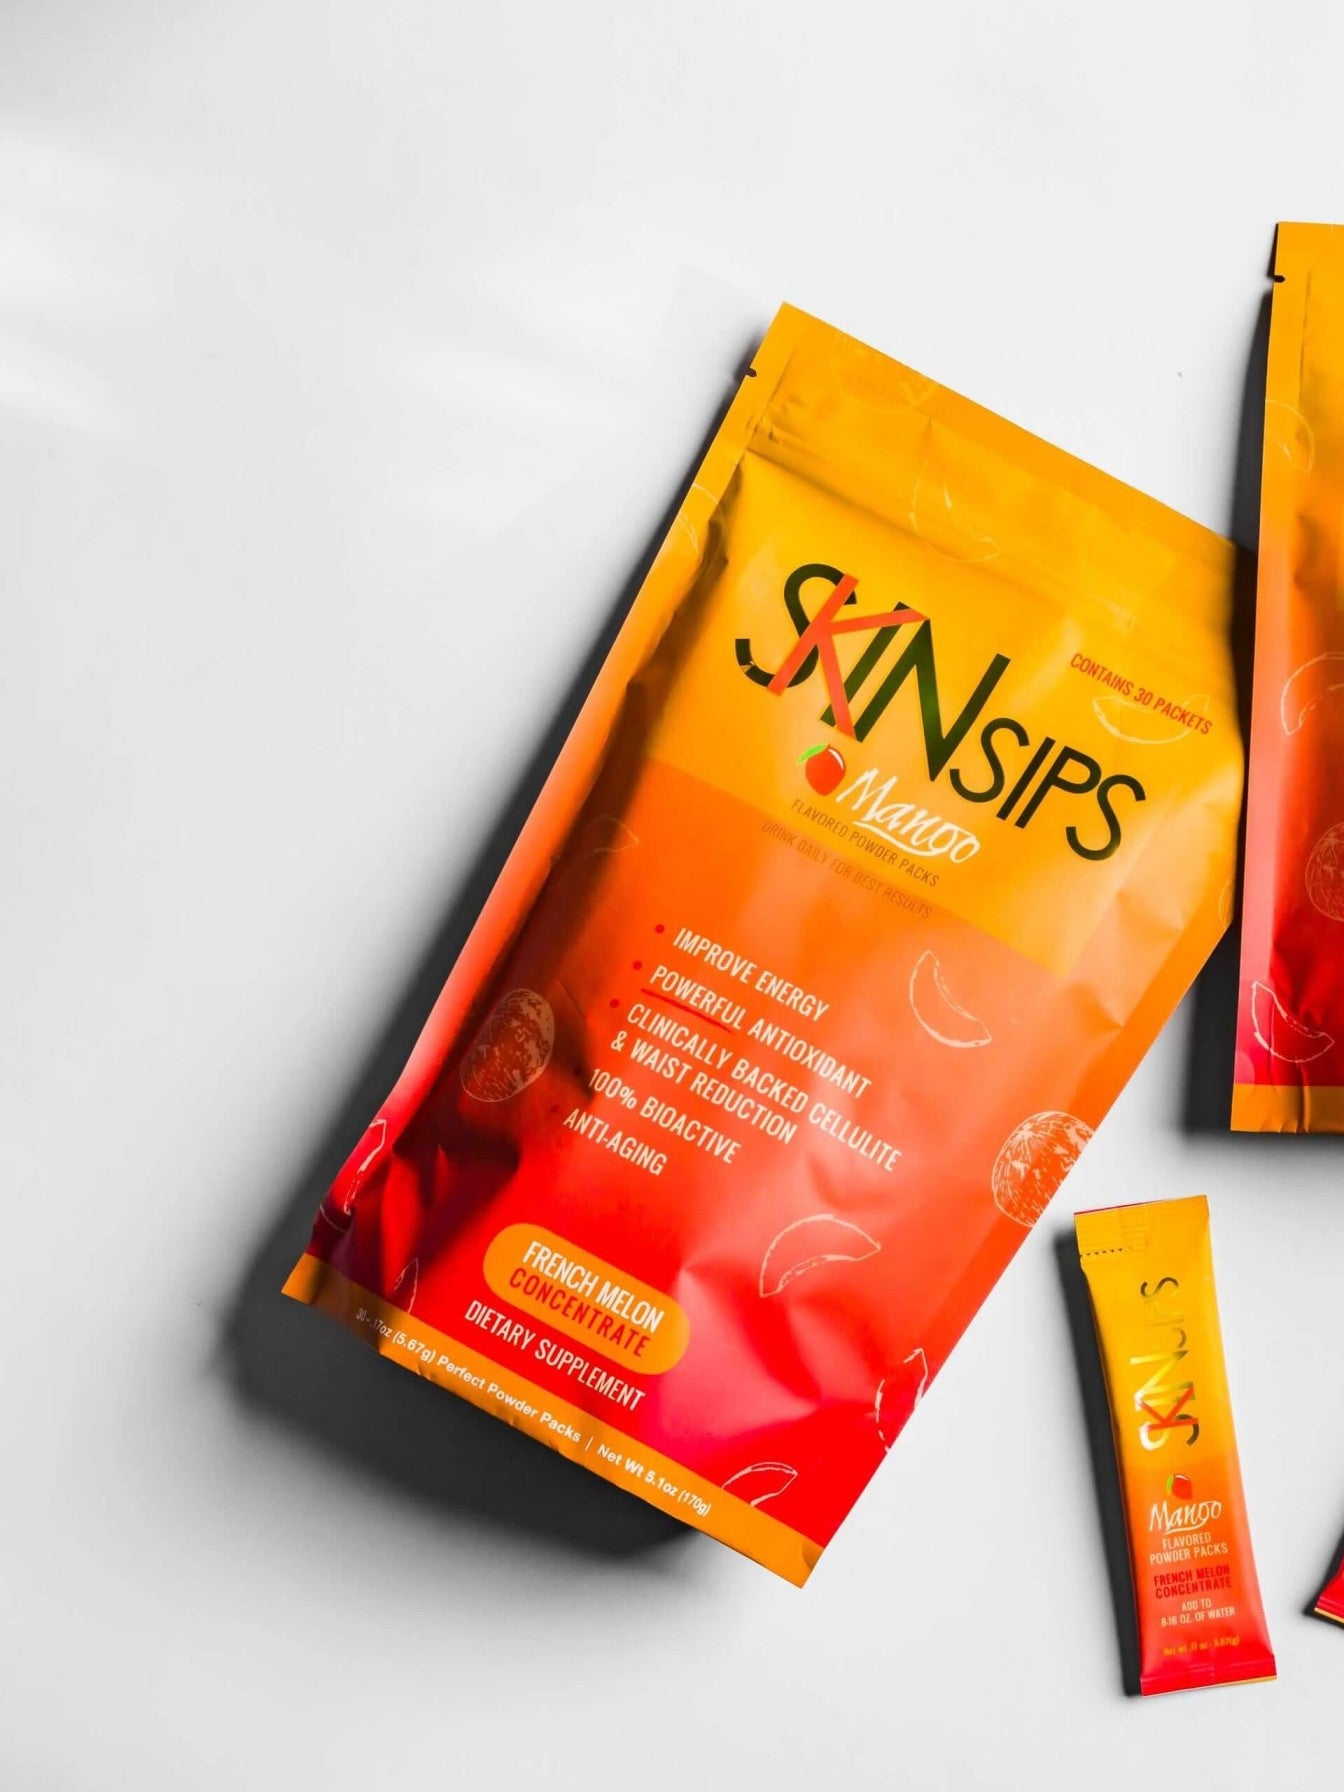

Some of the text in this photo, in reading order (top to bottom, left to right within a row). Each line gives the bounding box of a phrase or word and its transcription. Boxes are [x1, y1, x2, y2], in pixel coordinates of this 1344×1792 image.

[1070, 653, 1213, 734] CONTAINS 30 PACKETS
[791, 799, 939, 887] FLAVORED POWDER PACKS
[836, 768, 980, 863] Mango
[762, 820, 933, 919] DRINK DAILY FOR BEST RESULTS
[673, 927, 830, 1022] IMPROVE ENERGY
[650, 965, 872, 1099] POWERFUL ANTIOXIDANT
[589, 1068, 741, 1164] 100% BIOACTIVE
[610, 1031, 798, 1145] & WAIST REDUCTION
[627, 1003, 902, 1172] CLINICALLY BACKED CELLULITE
[563, 1108, 668, 1176] ANTI-AGING
[509, 1268, 650, 1357] CONCENTRATE
[523, 1241, 665, 1333] FRENCH MELON
[465, 1300, 646, 1411] DIETARY SUPPLEMENT
[392, 1330, 435, 1363] (5.67g)
[437, 1355, 485, 1389] Perfect
[487, 1382, 539, 1417] Powder
[539, 1412, 581, 1442] Packs
[597, 1444, 623, 1466] Net
[625, 1458, 645, 1477] Wt
[645, 1470, 678, 1497] 5.1oz
[677, 1490, 712, 1516] (170g)
[1149, 1500, 1222, 1535] Mango
[1150, 1542, 1228, 1566] POWDER PACKS
[1162, 1532, 1211, 1550] FLAVORED
[1154, 1565, 1230, 1587] FRENCH MELON
[1155, 1577, 1232, 1599] CONCENTRATE
[1182, 1598, 1212, 1612] ADD TO
[1196, 1612, 1205, 1622] OF
[1208, 1606, 1236, 1620] WATER
